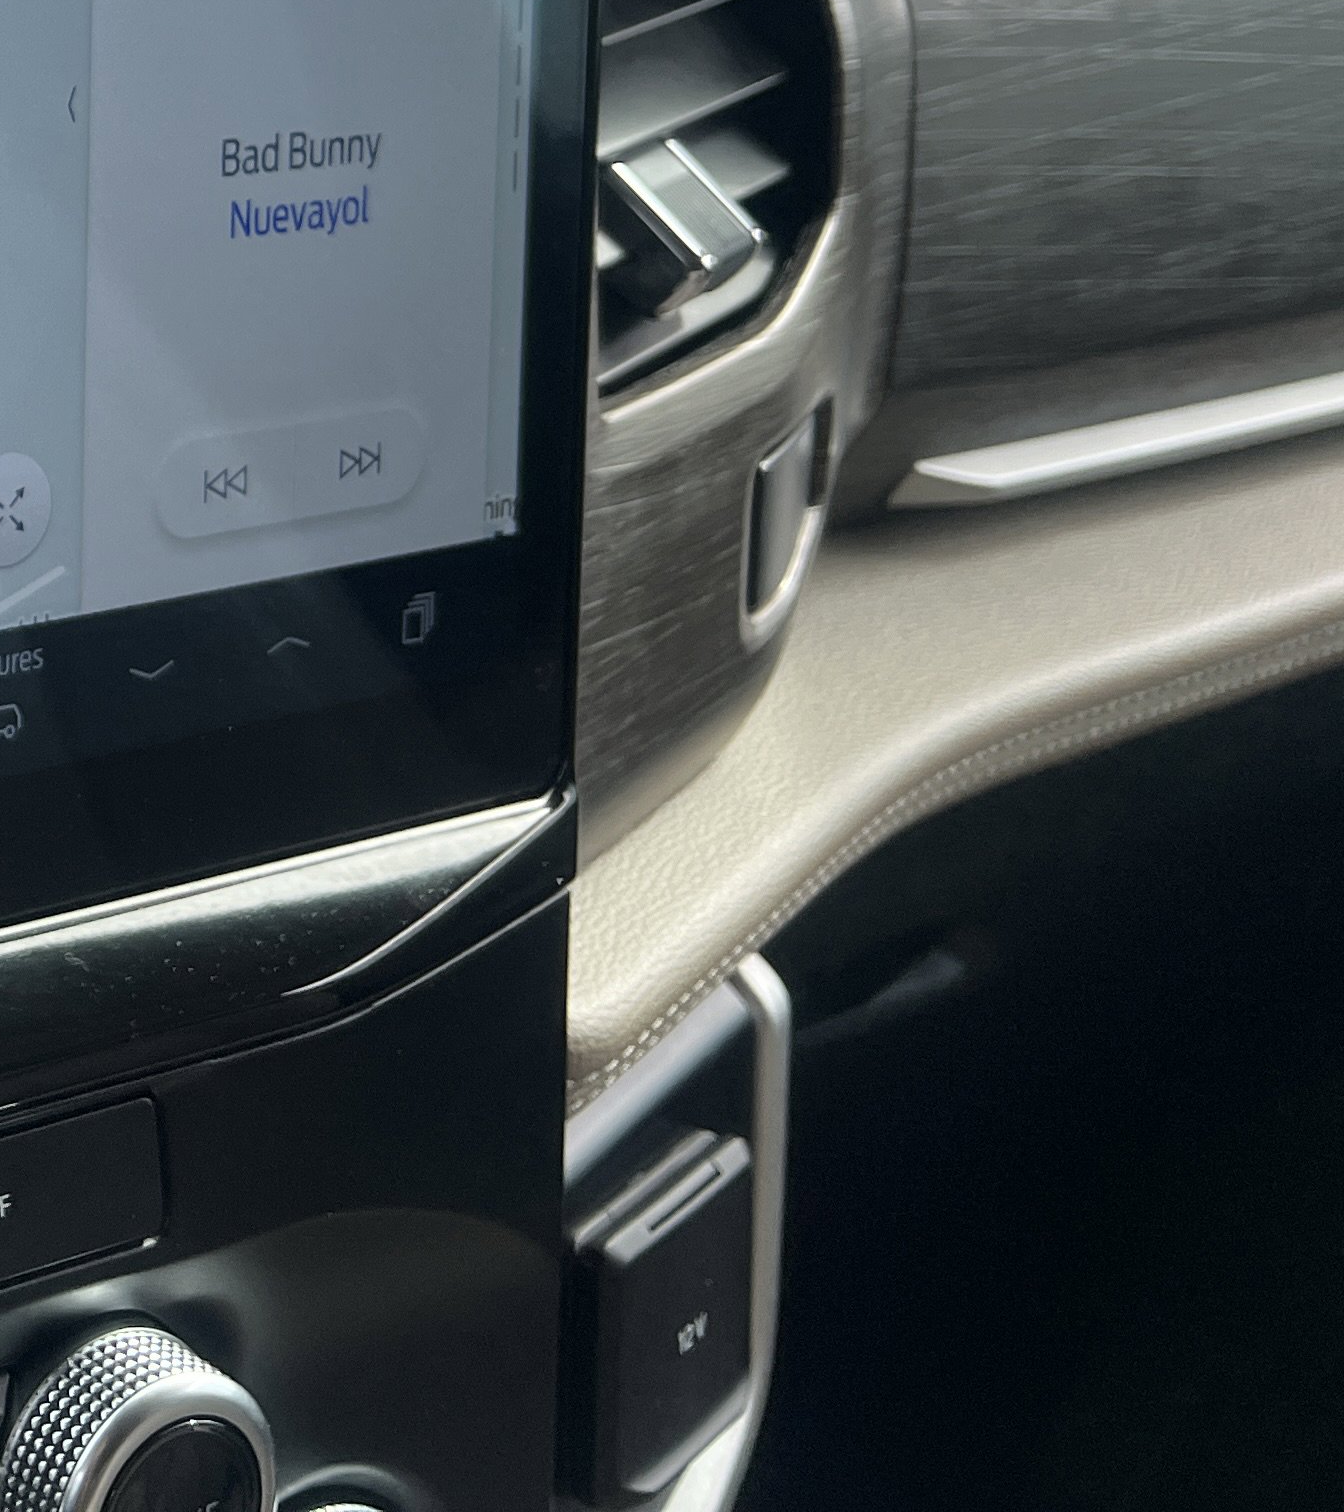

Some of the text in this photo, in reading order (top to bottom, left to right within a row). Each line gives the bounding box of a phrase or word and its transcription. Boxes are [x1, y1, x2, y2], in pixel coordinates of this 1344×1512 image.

[220, 129, 383, 177] Bad Bunny
[229, 184, 370, 239] Nuevayol
